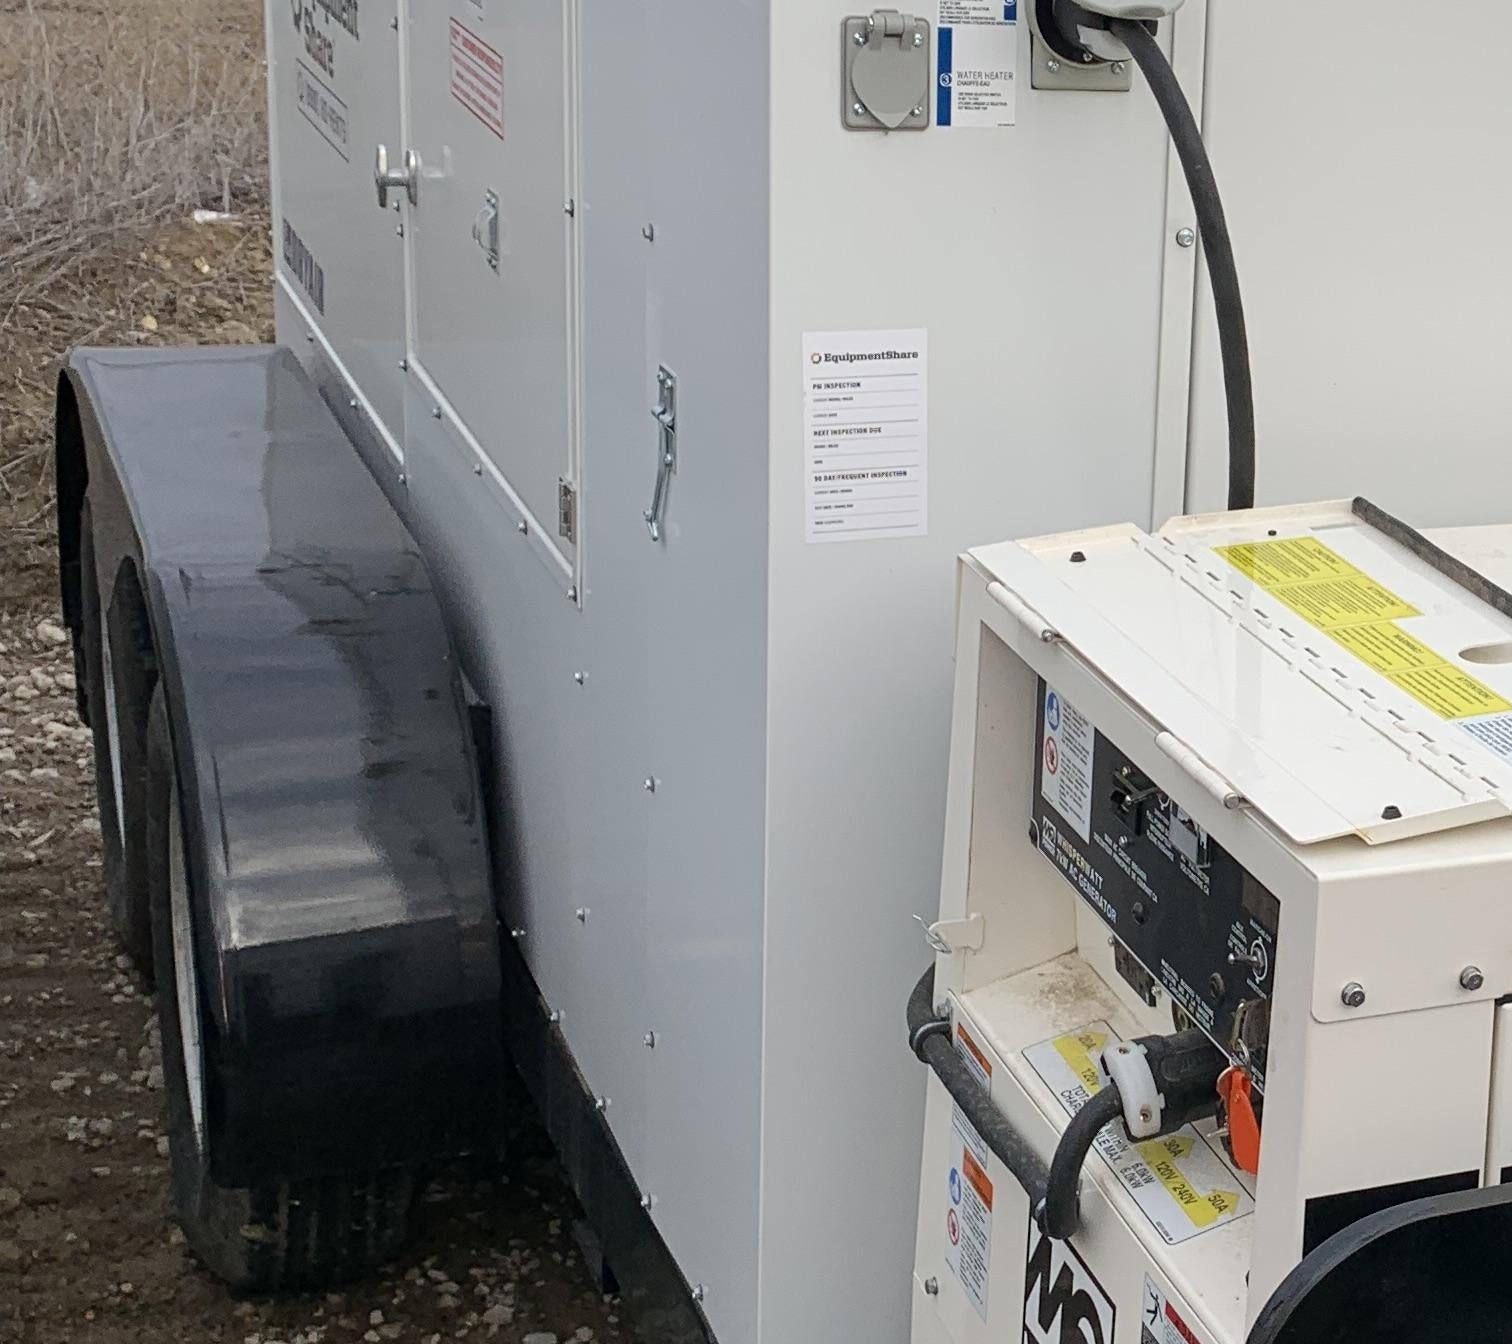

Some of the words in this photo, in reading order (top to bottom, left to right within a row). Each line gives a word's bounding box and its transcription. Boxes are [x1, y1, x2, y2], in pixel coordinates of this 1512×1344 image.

[957, 71, 983, 80] WATER
[984, 72, 1014, 81] HEATER
[823, 350, 919, 364] EquipmentShare
[824, 382, 861, 390] INSPECTION
[830, 427, 868, 436] INSPECTION
[869, 426, 882, 434] DUE
[870, 470, 907, 479] INSPECTION
[1057, 831, 1104, 890] WHISPERWATT
[1078, 873, 1117, 924] GENERATOR
[1078, 1033, 1097, 1049] 20A
[1163, 1138, 1185, 1158] 30A
[1207, 1193, 1229, 1214] 50A
